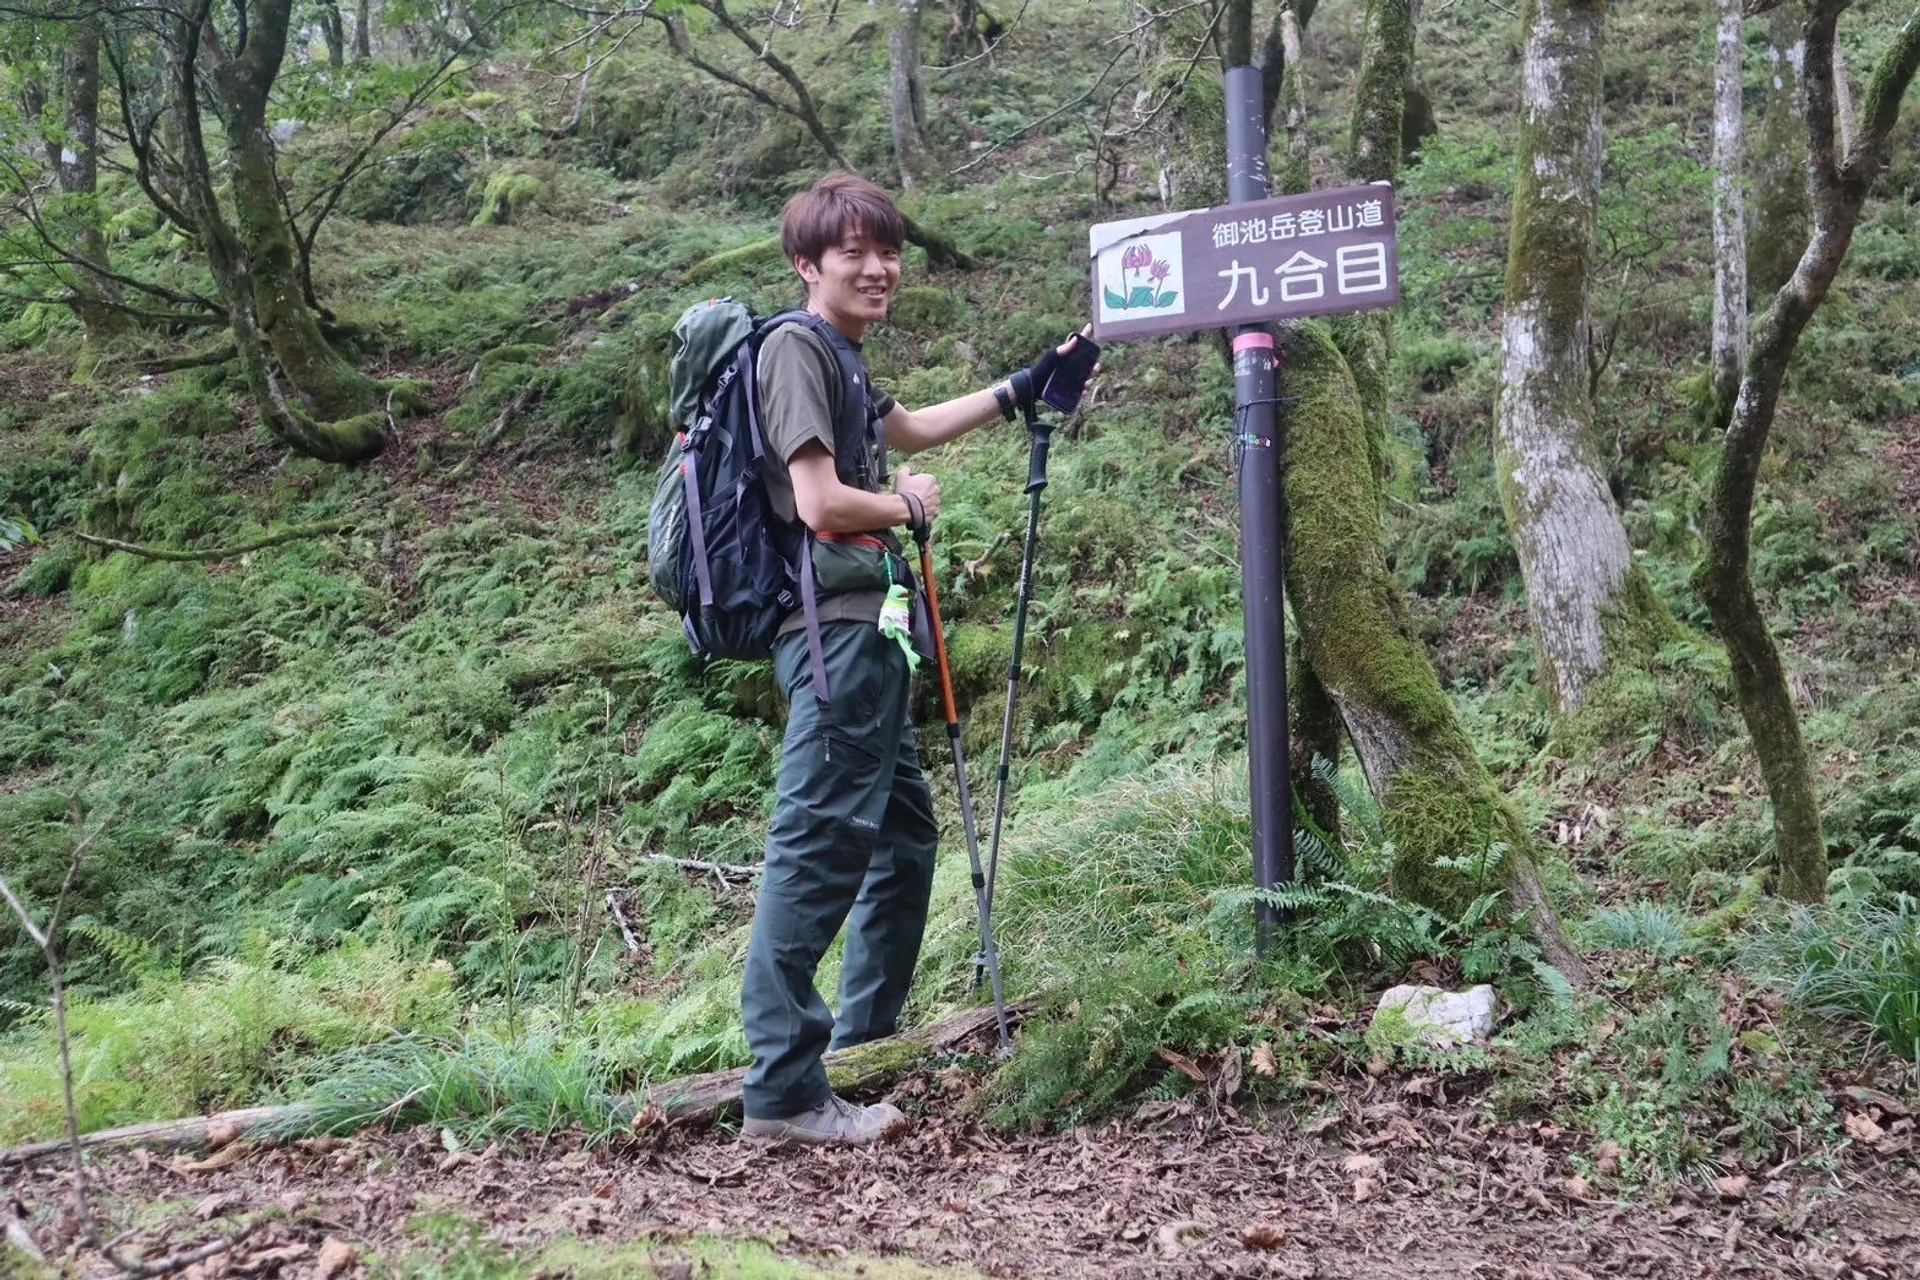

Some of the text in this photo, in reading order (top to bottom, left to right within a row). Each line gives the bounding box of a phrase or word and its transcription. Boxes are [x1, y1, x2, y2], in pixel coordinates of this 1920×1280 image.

[1212, 199, 1384, 248] 御池岳登山道
[1218, 242, 1388, 310] 九合目
